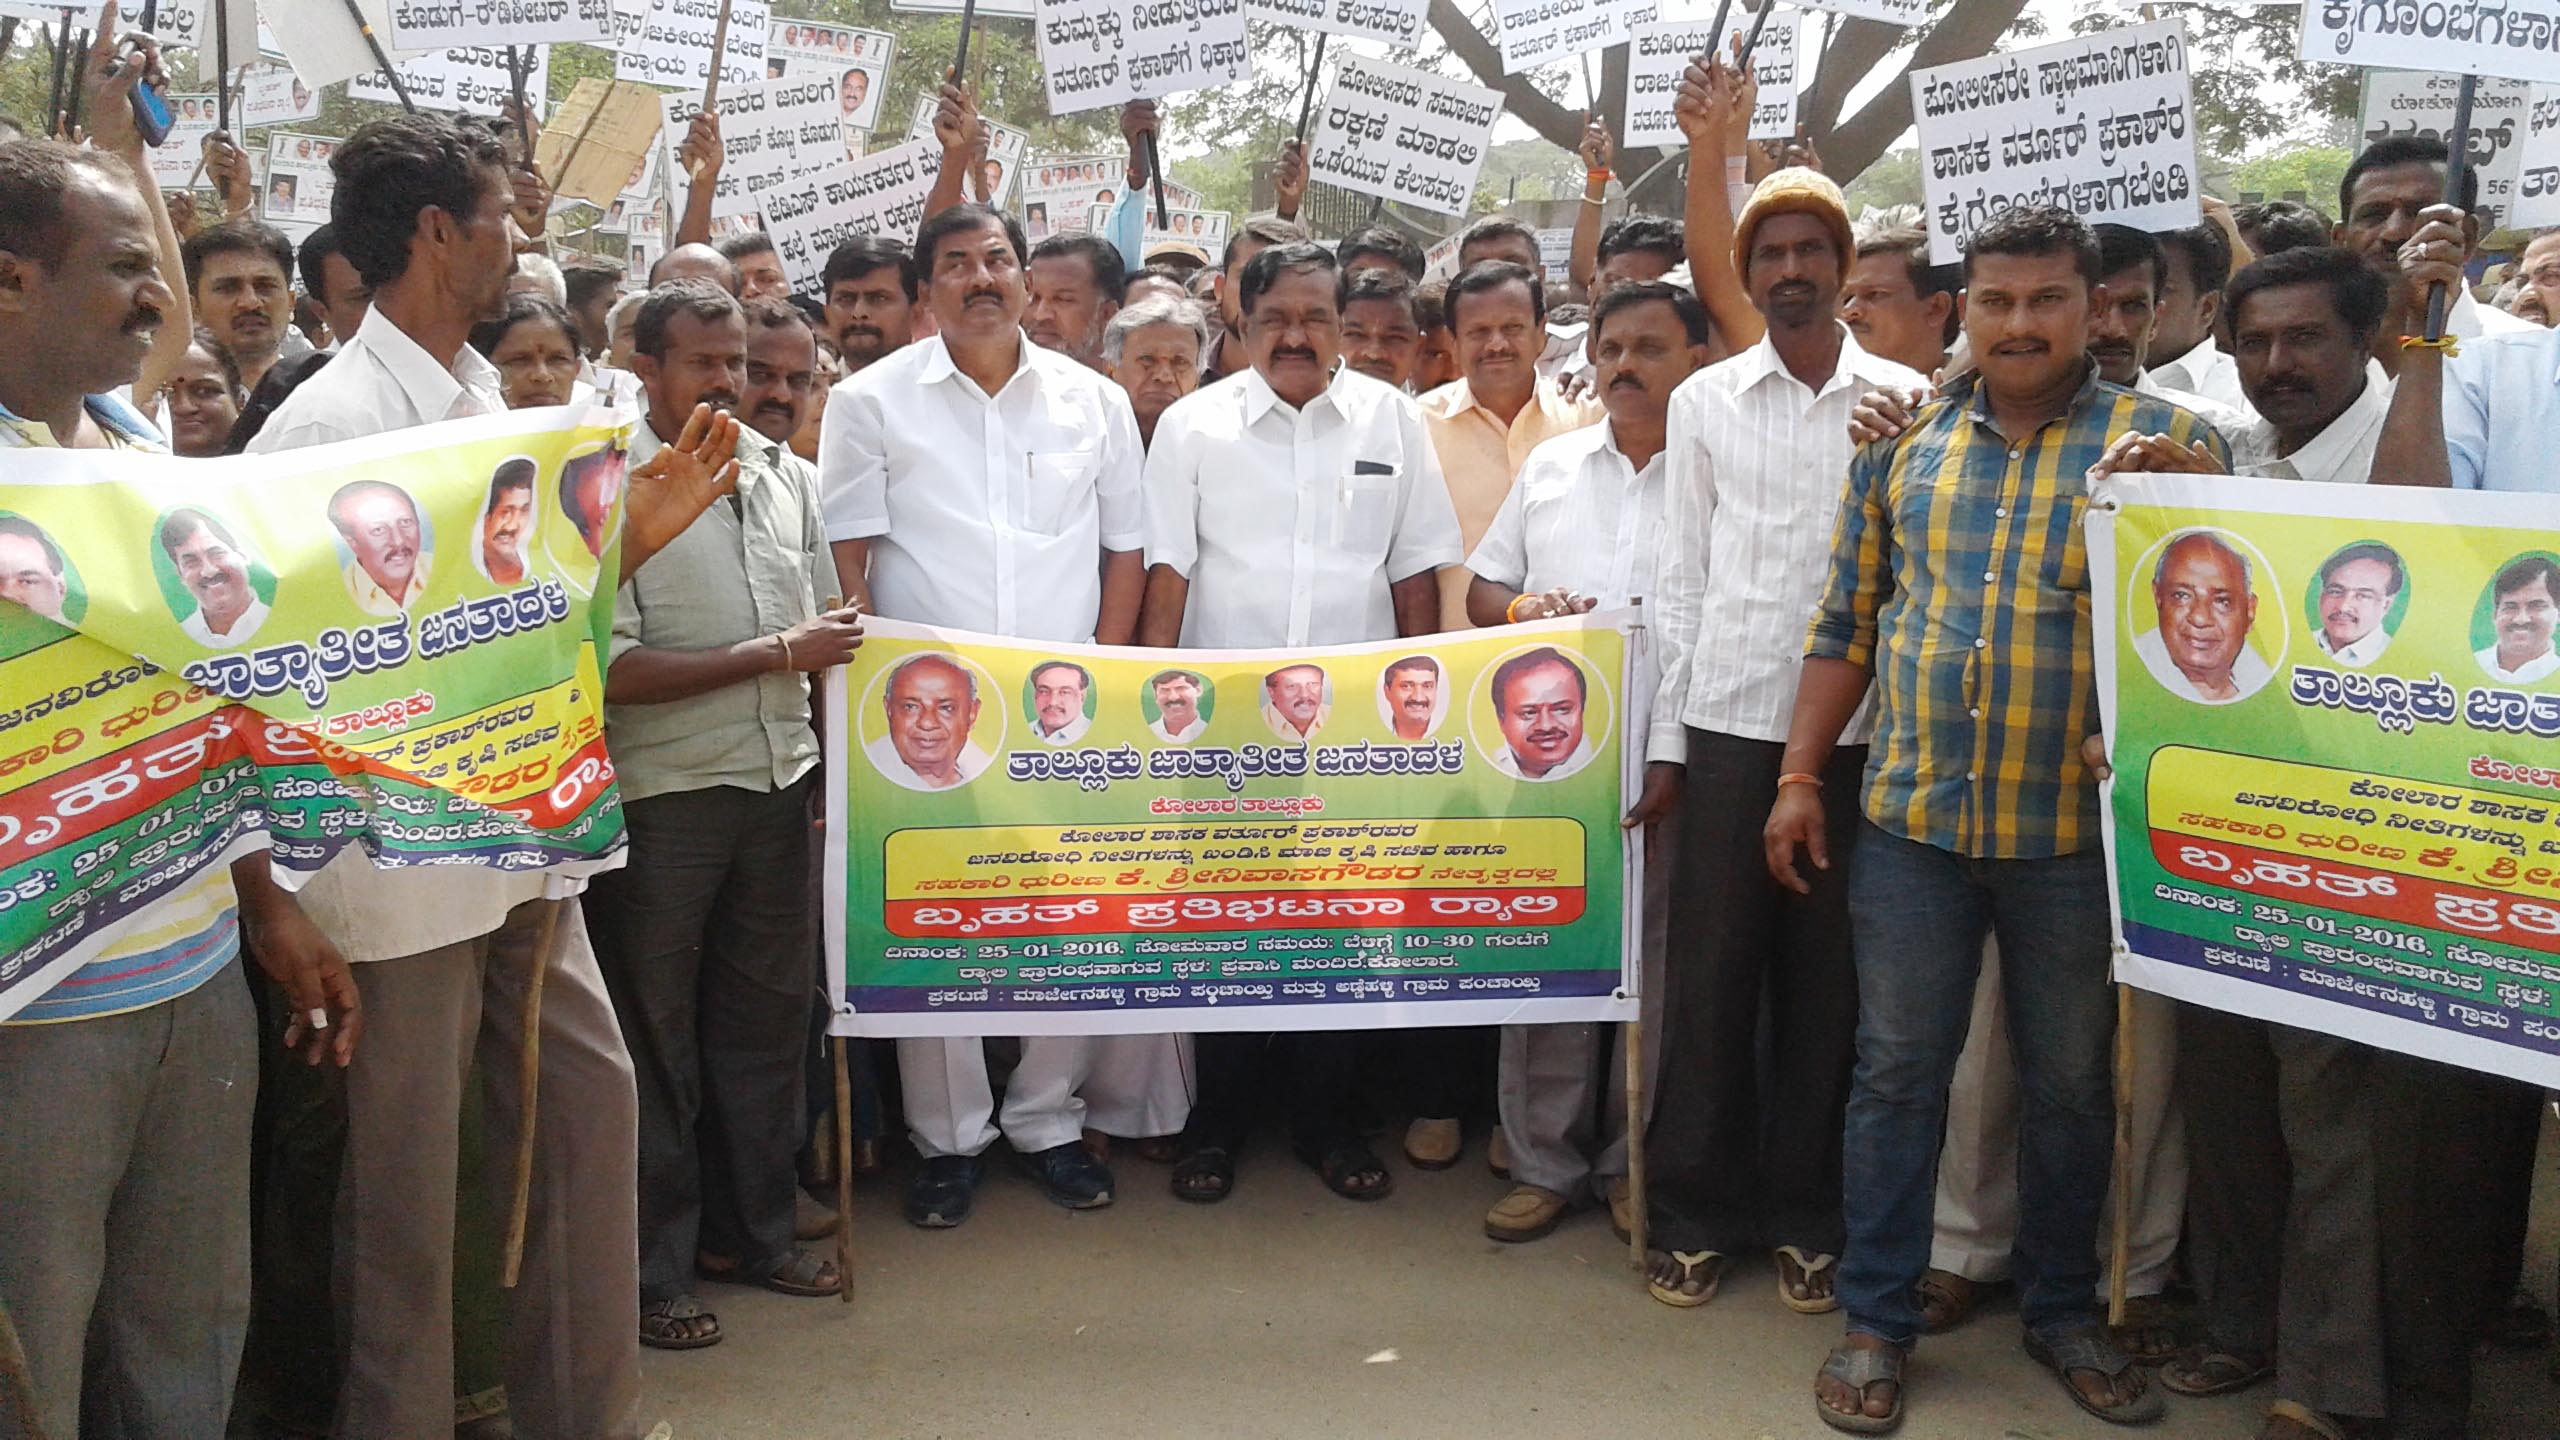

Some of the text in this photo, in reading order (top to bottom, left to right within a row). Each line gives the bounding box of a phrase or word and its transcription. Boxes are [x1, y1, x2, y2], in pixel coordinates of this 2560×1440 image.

[727, 34, 763, 59] ಬೇಡ
[775, 77, 836, 106] ಜನರಿಗೆ
[1426, 88, 1496, 128] ಸಮಾಜದ
[1328, 104, 1478, 166] ರಕ್ಷಣೆ ಮಾಡಲಿ
[1932, 129, 1991, 179] ಶಾಸಕ
[2001, 111, 2087, 168] ವರ್ತೂರ್
[1394, 162, 1466, 212] ಕೆಲಸವಲ್ಲ
[180, 577, 569, 708] ಜಾತ್ಯಾತೀತ ಜನತಾದಳ
[327, 689, 434, 735] ತಾಲ್ಲೂಕು
[2291, 666, 2457, 734] ತಾಲ್ಲೂಕು
[456, 743, 497, 776] ಕೃಷಿ
[504, 721, 560, 756] ಸಚಿವ
[1008, 737, 1464, 791] ತಾಲ್ಲೂಕು ಜಾತ್ಯಾತೀತ ಜನತಾದಳ
[1150, 794, 1324, 818] ಕೋಲಾರ ತಾಲ್ಲೂಕು
[2235, 791, 2377, 826] ಜನವಿರೋಧಿ
[2385, 812, 2527, 856] ನೀತಿಗಳನ್ನು
[2350, 778, 2462, 811] ಕೋಲಾರ
[2468, 798, 2549, 824] ಶಾಸಕ
[967, 843, 1507, 866] ಜನವಿರೋಧಿ ನೀತಿಗಳನ್ನು ಖಂಡಿಸಿ ಮಾಜಿ ಕೃಷಿ ಸಚಿವ ಹಾಗೂ
[1059, 827, 1145, 843] ಕೋಲಾರ
[1150, 826, 1208, 841] ಶಾಸಕ
[1212, 824, 1297, 840] ವರ್ತೂರ್
[2178, 812, 2287, 840] ಸಹಕಾರಿ
[2296, 832, 2406, 861] ಧುರೀಣ
[2418, 846, 2465, 873] ಕೆ.
[915, 875, 1011, 891] ಸಹಕಾರಿ
[1019, 873, 1106, 889] ಧುರೀಣ
[1115, 868, 1151, 886] ಕೆ.
[1156, 862, 1424, 891] ಶ್ರೀನಿವಾಸಗೌಡರ
[2180, 846, 2398, 897] ಬೃಹತ್
[913, 899, 1100, 933] ಬೃಹತ್
[1128, 896, 1405, 927] ಪ್ರತಿಭಟನಾ
[2154, 883, 2243, 915] ದಿನಾಂಕ:
[885, 946, 968, 960] ದಿನಾಂಕ:
[978, 941, 1124, 959] 25-01-2016.
[1135, 938, 1248, 954] ಸೋಮವಾರ
[1257, 935, 1333, 951] ಸಮಯ:
[1403, 934, 1474, 949] 10-30
[1485, 931, 1549, 947] ಗಂಟೆಗೆ
[2302, 939, 2483, 992] ಪ್ರಾರಂಭವಾಗುವ
[928, 988, 989, 1006] ಪ್ರಕಟಣೆ
[1134, 983, 1182, 1002] ಗ್ರಾಮ
[1282, 981, 1326, 998] ಮತ್ತು
[1403, 977, 1449, 996] ಗ್ರಾಮ
[1018, 960, 1162, 982] ಪ್ರಾರಂಭವಾಗುವ
[1221, 956, 1281, 977] ಪ್ರವಾಸಿ
[2204, 945, 2271, 973] ಪ್ರಕಟಣೆ
[2449, 1002, 2510, 1029] ಗ್ರಾಮ
